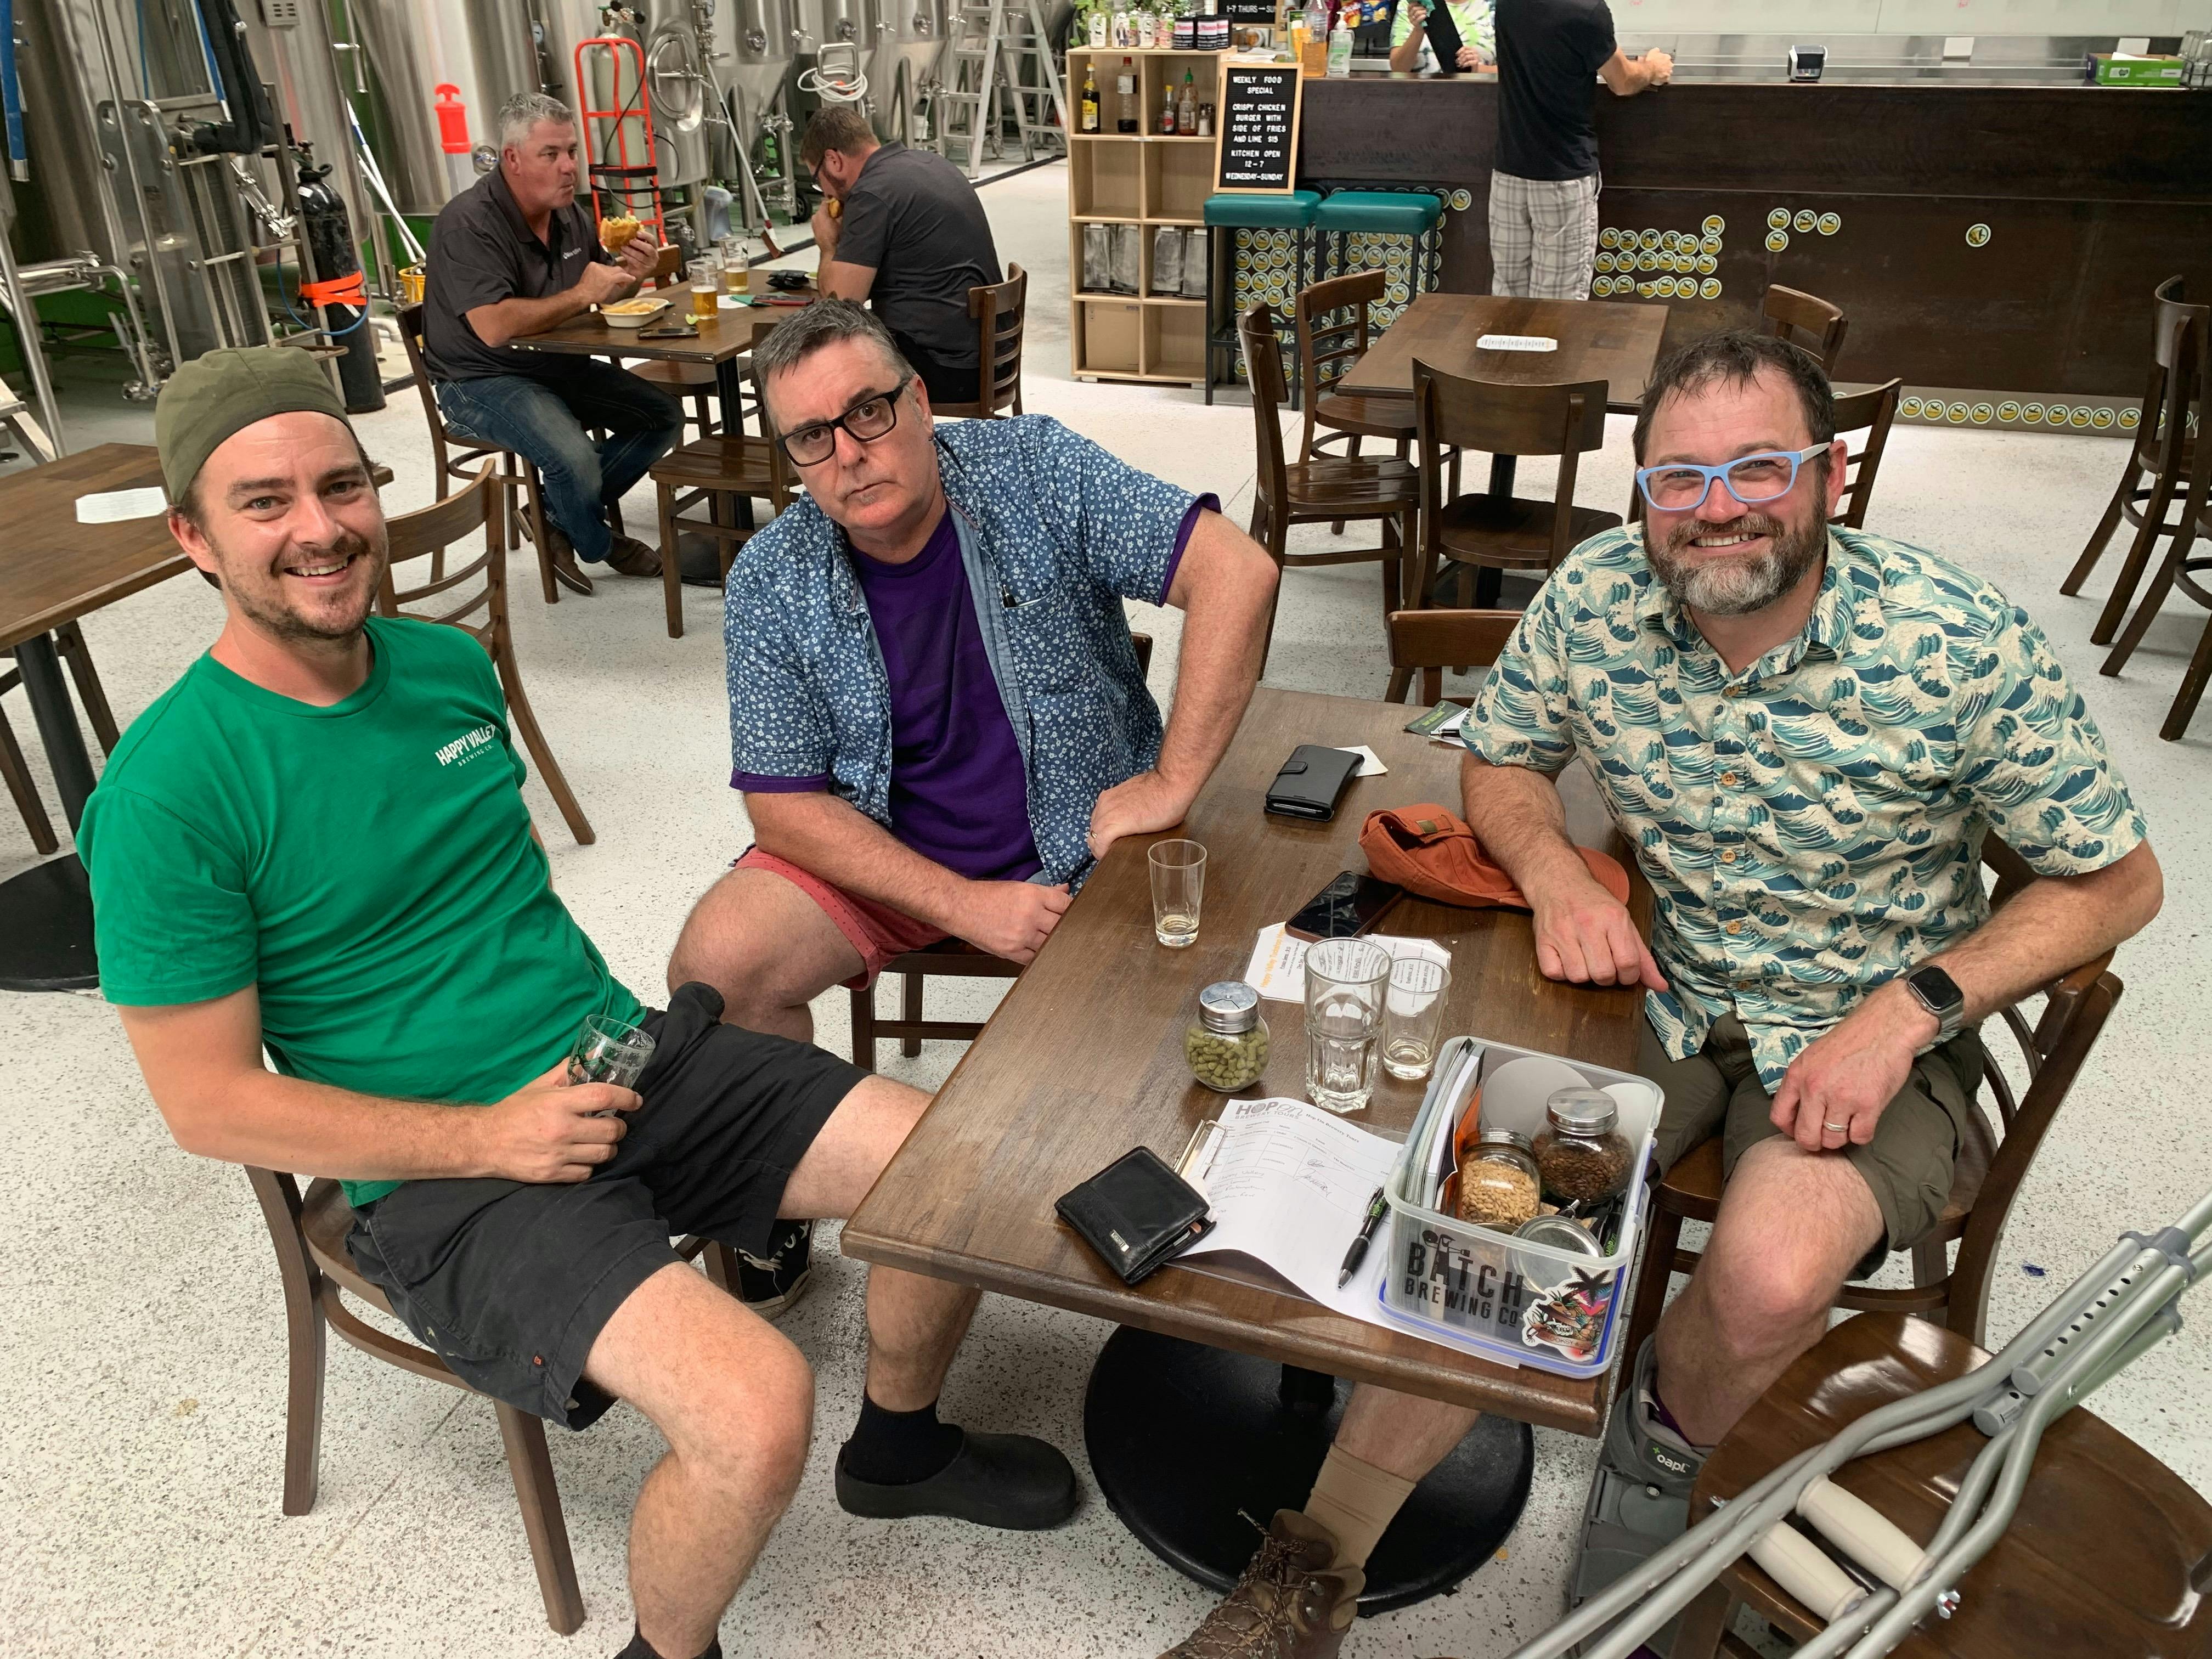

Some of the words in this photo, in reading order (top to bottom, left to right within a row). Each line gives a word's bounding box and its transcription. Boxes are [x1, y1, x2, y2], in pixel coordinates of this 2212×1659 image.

[435, 736, 470, 766] HAPPY
[466, 724, 495, 748] VALLEY
[458, 749, 484, 766] BREWING
[1234, 1111, 1270, 1119] BREWERY
[1274, 1110, 1299, 1119] TOURS
[1235, 1102, 1279, 1115] HOP
[1370, 1203, 1381, 1217] HOP
[1605, 1240, 1615, 1256] HOP
[1407, 1240, 1524, 1308] BATCH
[1404, 1277, 1492, 1319] BREWING
